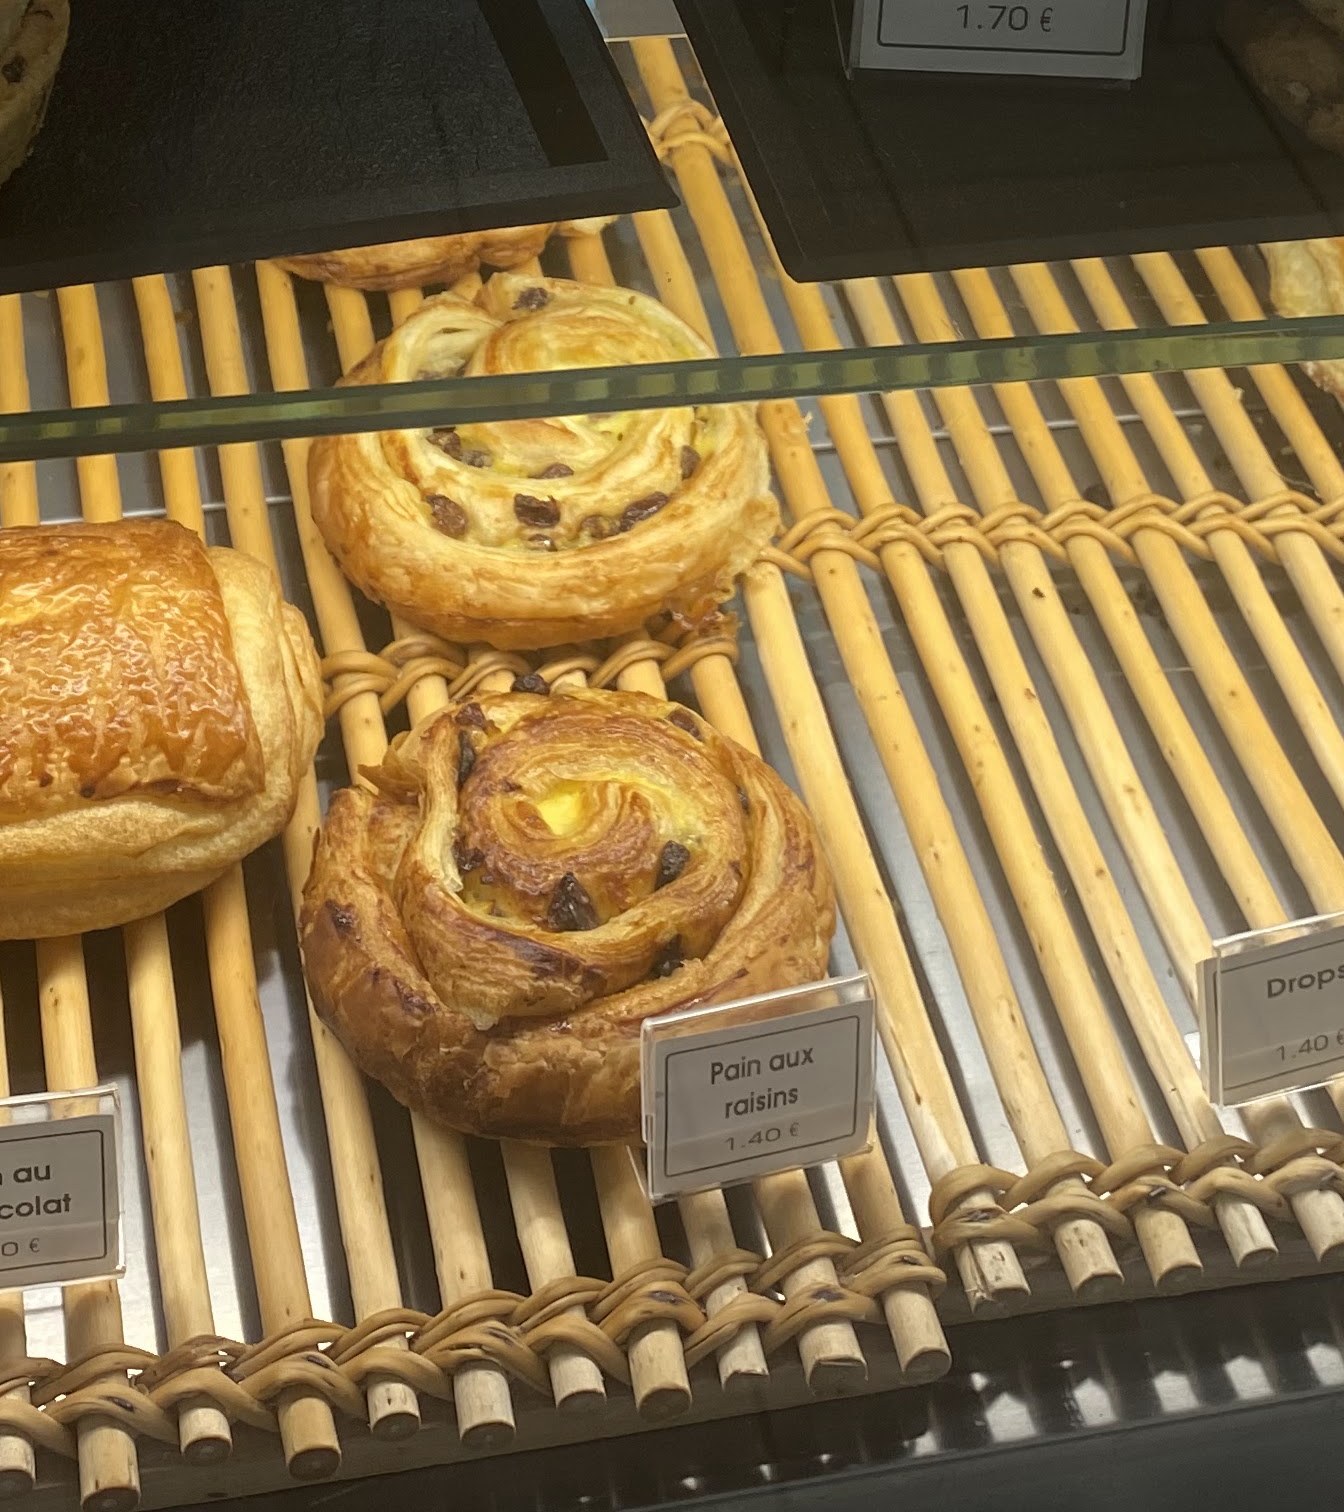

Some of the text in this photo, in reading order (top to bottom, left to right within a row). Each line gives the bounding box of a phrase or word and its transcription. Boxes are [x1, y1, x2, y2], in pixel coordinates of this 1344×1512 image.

[956, 4, 1054, 33] 1.70 €
[1275, 1034, 1330, 1062] 1.40
[710, 1047, 815, 1085] Pain aux
[724, 1087, 799, 1119] raisins
[724, 1127, 781, 1151] 1.40
[12, 1164, 51, 1184] au
